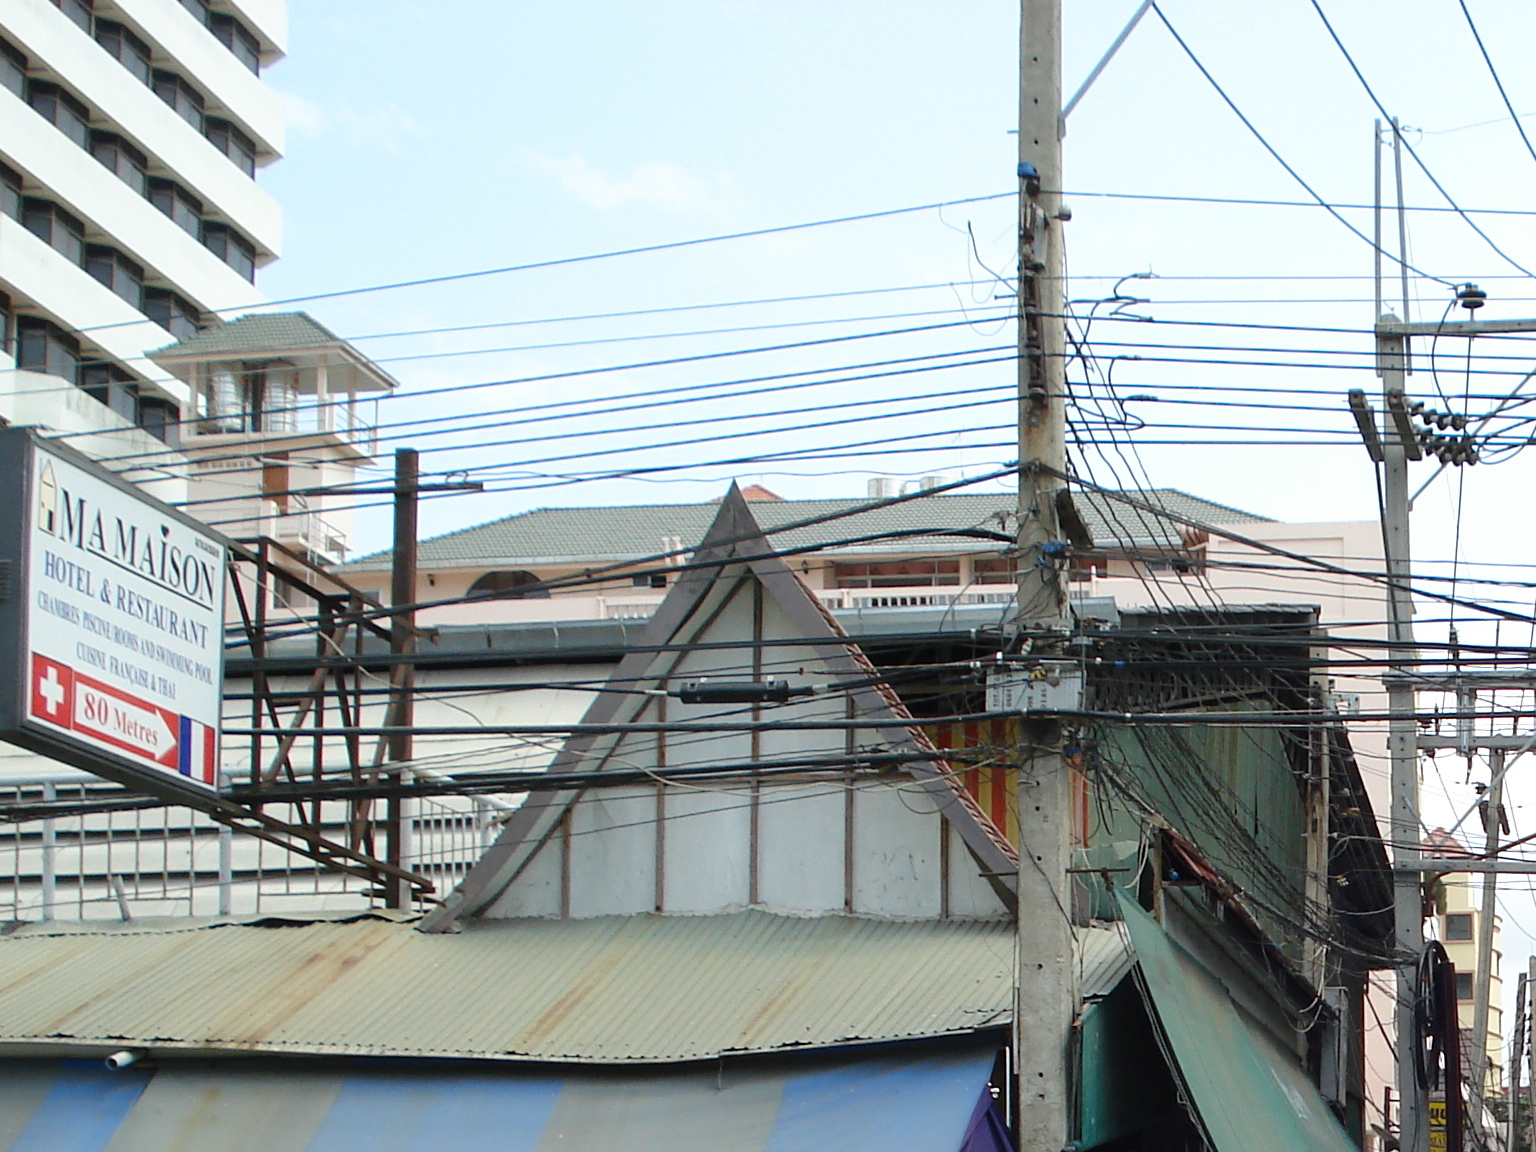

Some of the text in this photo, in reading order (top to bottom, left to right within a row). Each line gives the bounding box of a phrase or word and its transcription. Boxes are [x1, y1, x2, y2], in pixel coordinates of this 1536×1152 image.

[60, 487, 106, 551] MA
[44, 550, 208, 649] HOTEL & RESTAURANT
[38, 590, 80, 625] CHAMBRES
[141, 638, 156, 660] AND
[194, 660, 213, 685] POOL
[76, 641, 106, 670] CUISINE
[158, 676, 176, 699] THAI
[84, 692, 159, 746] 80 Metres
